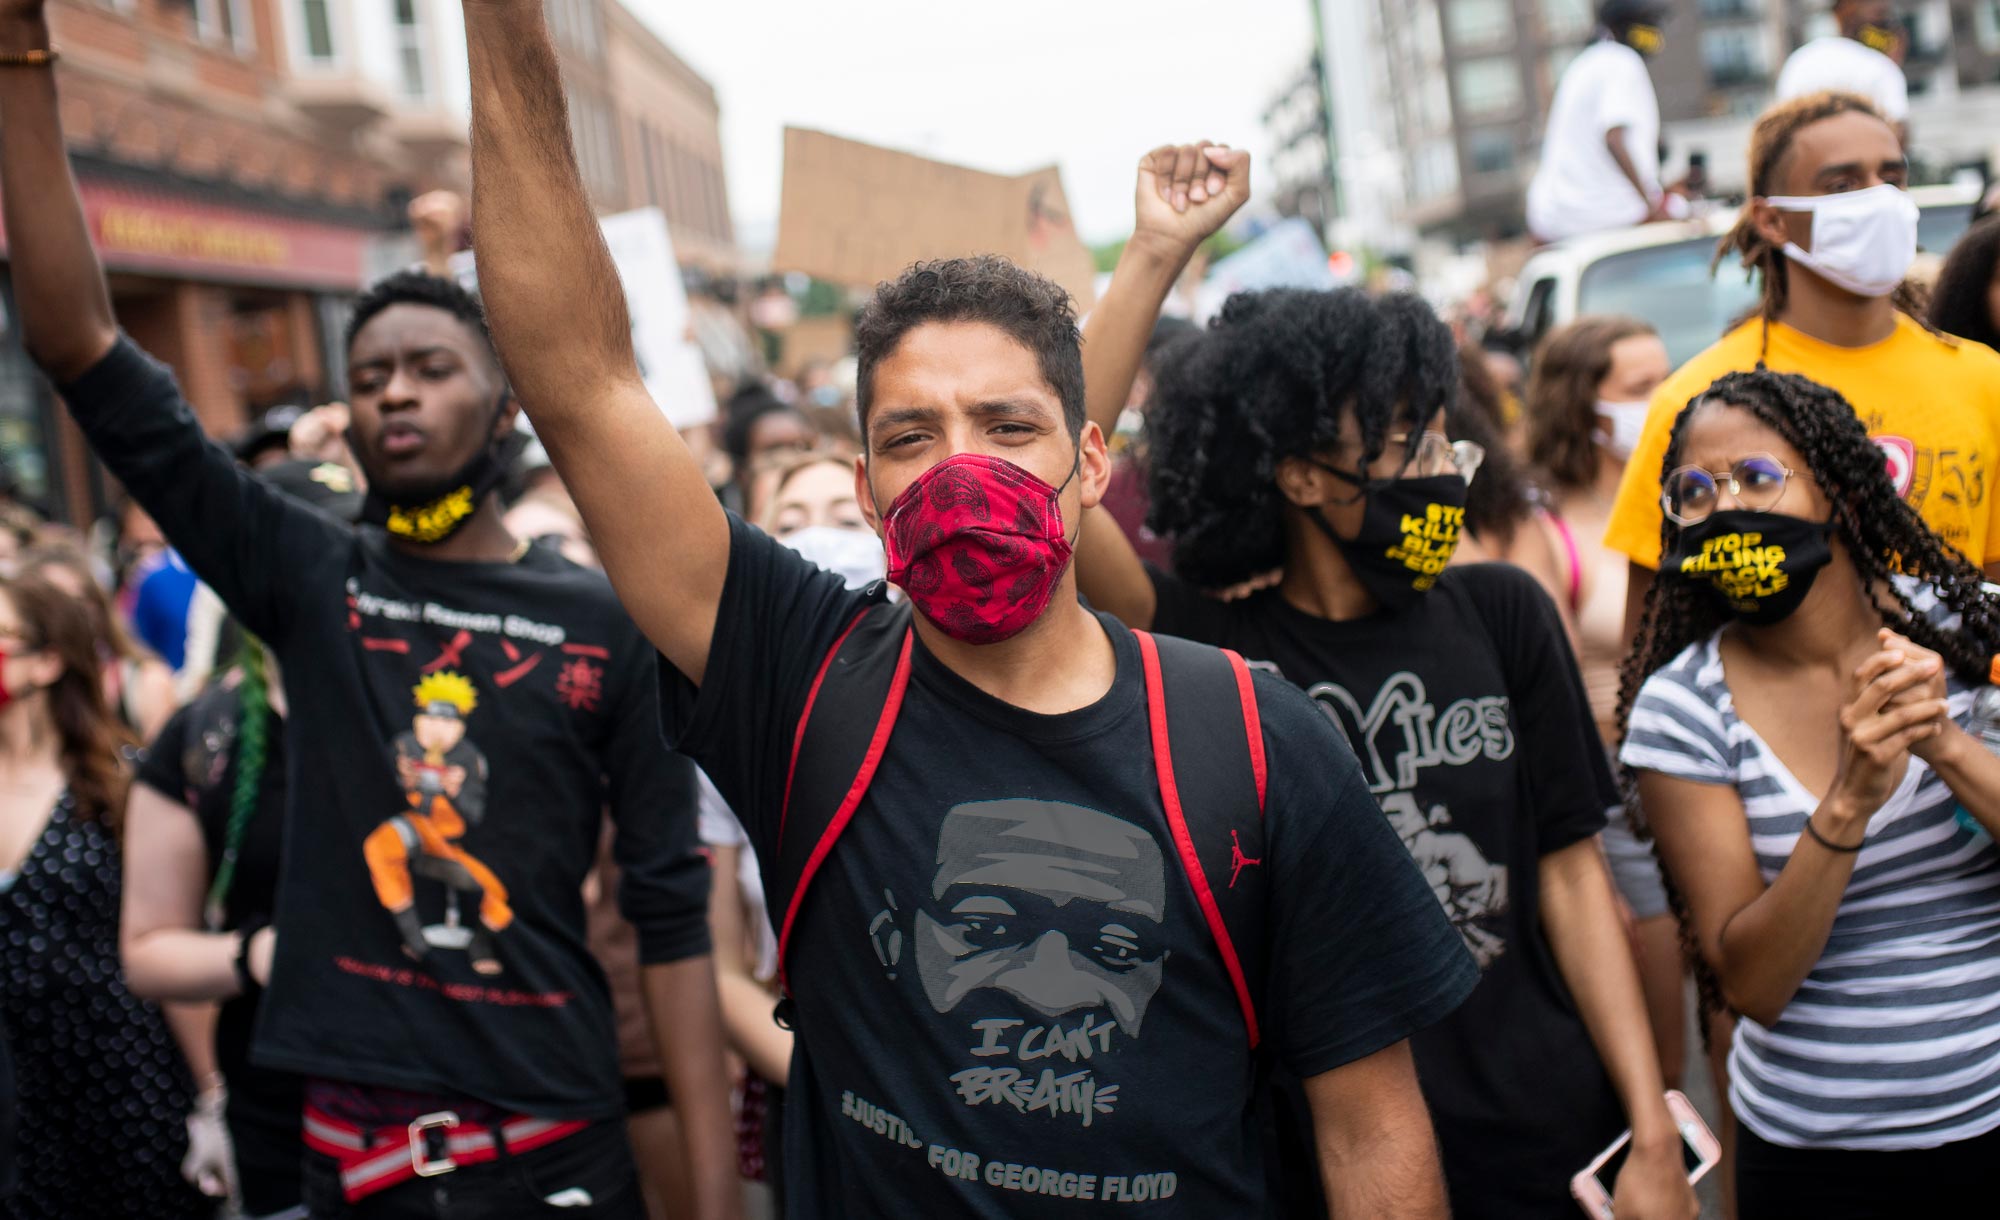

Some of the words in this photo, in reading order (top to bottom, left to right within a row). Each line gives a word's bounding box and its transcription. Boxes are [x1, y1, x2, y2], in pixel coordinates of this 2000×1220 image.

[1400, 513, 1460, 543] KILL
[1425, 503, 1465, 527] STO
[1403, 534, 1457, 559] BLA
[1702, 531, 1763, 554] STOP
[1680, 545, 1787, 573] KILLING
[422, 601, 502, 634] Ramen
[503, 614, 566, 647] Shop
[969, 1018, 1025, 1057] I
[1017, 1013, 1117, 1063] CAN'T
[927, 1144, 981, 1182] FOR
[984, 1160, 1098, 1201] GEORGE
[1101, 1170, 1178, 1203] FLOYD
